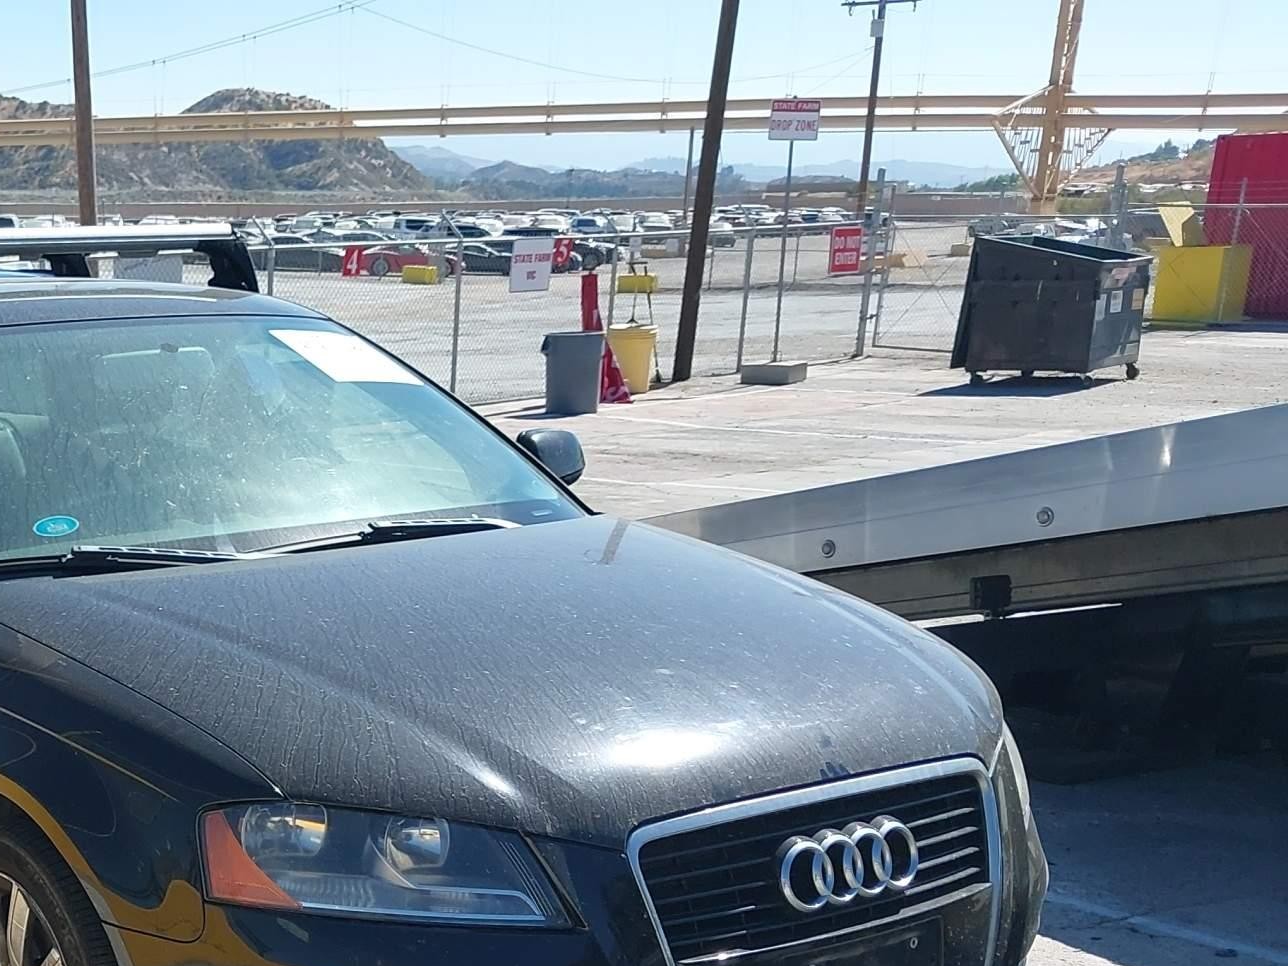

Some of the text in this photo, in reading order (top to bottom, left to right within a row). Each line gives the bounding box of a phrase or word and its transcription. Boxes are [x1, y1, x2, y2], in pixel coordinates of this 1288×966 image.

[771, 119, 818, 132] DROP ZONE
[833, 235, 845, 249] DO
[557, 239, 570, 262] 5
[346, 249, 359, 274] 4
[513, 252, 552, 264] STATE FARM
[834, 251, 858, 265] ENTER
